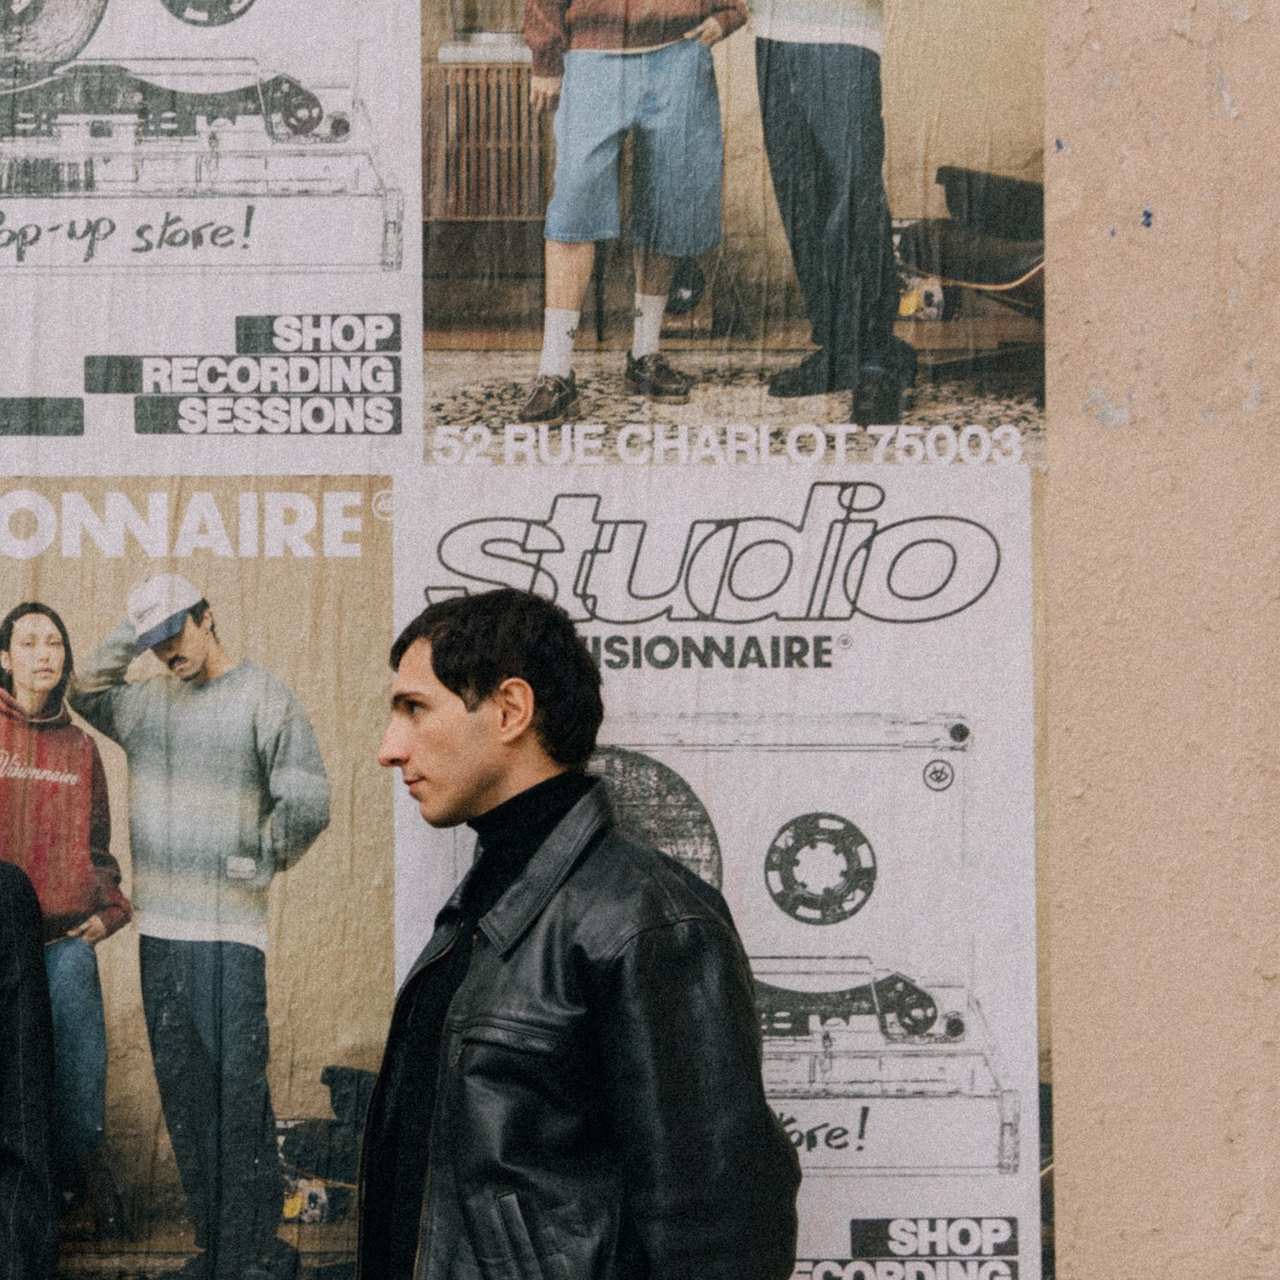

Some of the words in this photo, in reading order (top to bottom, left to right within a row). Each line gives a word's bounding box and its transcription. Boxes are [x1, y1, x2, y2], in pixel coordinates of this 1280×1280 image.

[131, 204, 257, 254] store!
[271, 314, 395, 353] SHOP
[140, 355, 395, 393] RECORDING
[177, 396, 395, 435] SESSIONS
[432, 423, 492, 468] 52
[503, 423, 605, 468] RUE
[616, 423, 858, 468] CHARLOT
[871, 422, 1022, 468] 75003
[581, 635, 833, 670] ISIONNAIRE
[887, 1218, 1012, 1257] SHOP
